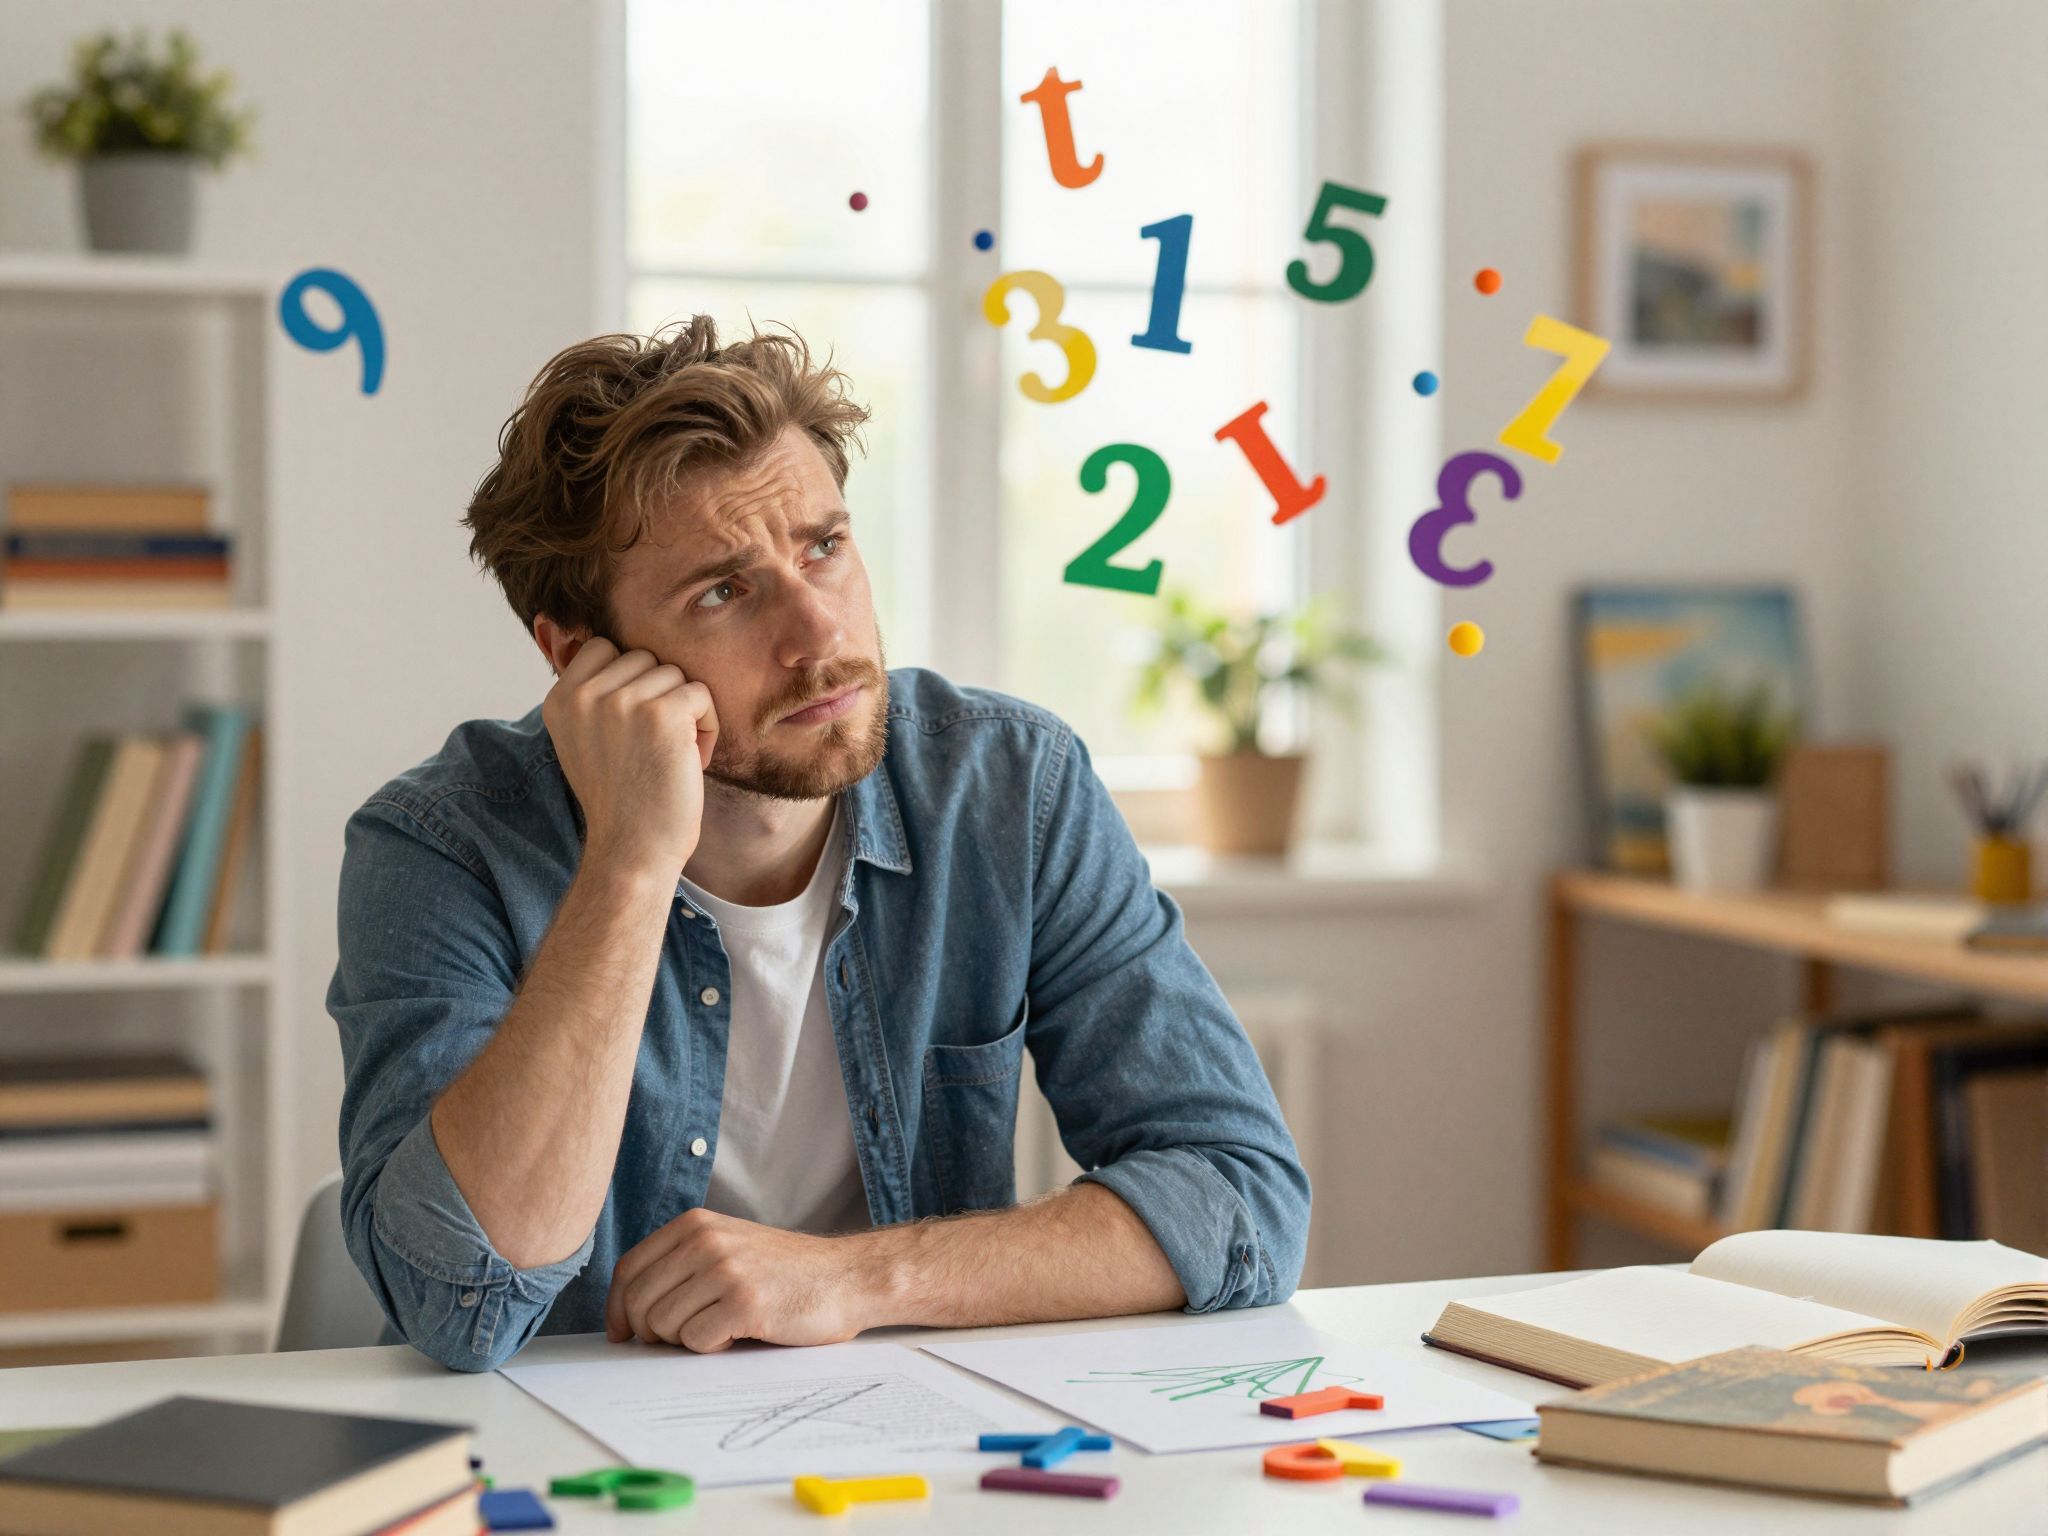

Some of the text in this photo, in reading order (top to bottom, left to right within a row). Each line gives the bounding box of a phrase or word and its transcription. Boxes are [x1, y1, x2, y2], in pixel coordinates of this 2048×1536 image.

[1020, 66, 1105, 190] t
[1130, 213, 1194, 355] 1
[1286, 180, 1388, 304] 5
[279, 267, 387, 397] 9
[983, 269, 1098, 405] 3
[1063, 442, 1173, 598] 2
